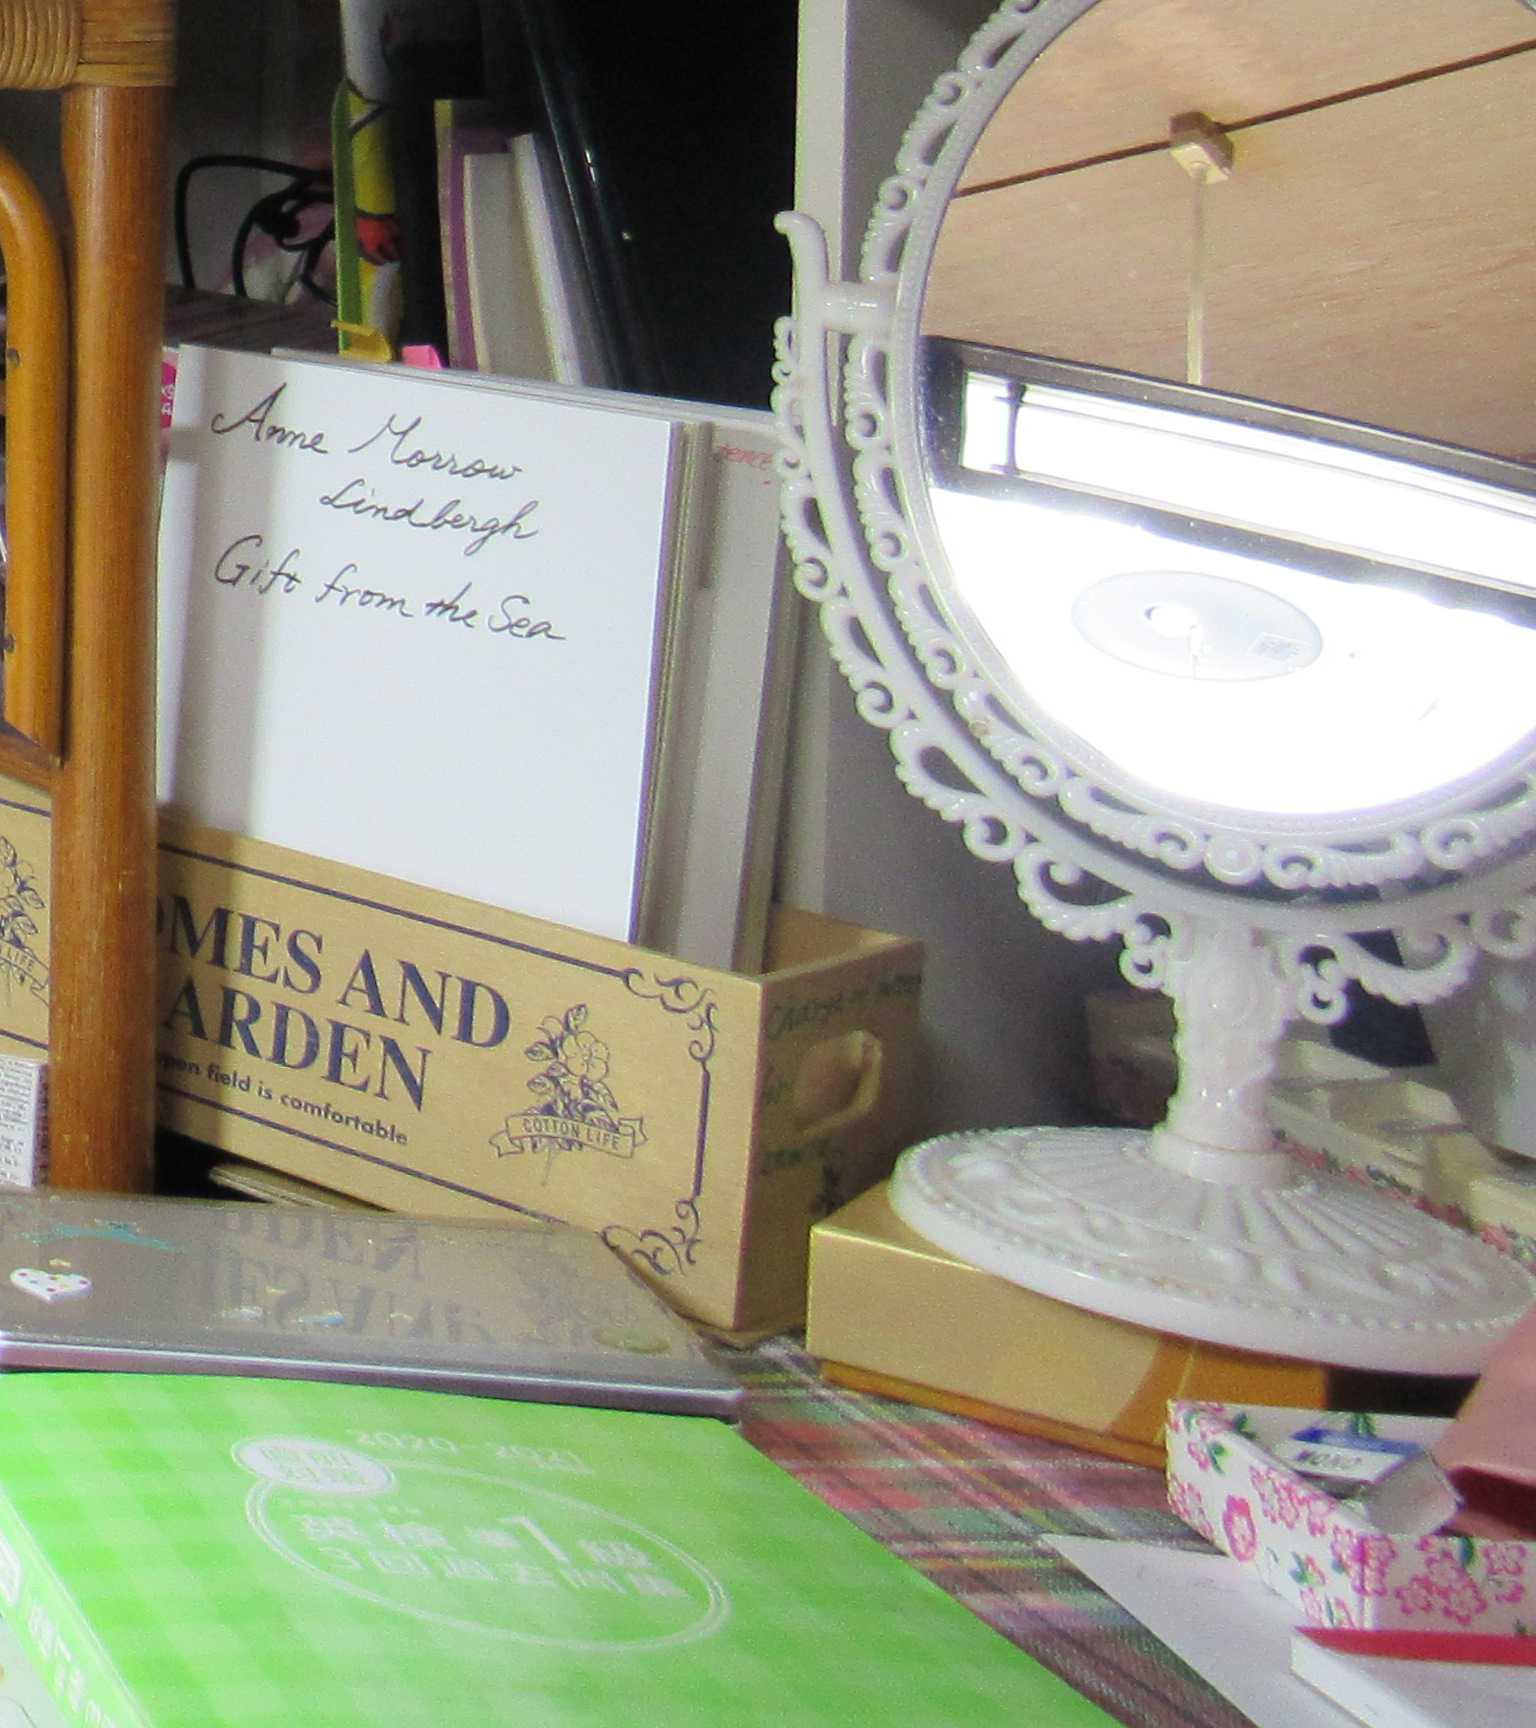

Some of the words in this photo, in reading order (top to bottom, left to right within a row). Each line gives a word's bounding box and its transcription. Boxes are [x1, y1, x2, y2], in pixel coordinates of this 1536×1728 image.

[211, 382, 330, 454] Anne
[347, 413, 524, 481] Morrow
[318, 478, 539, 557] Lindbergh
[213, 534, 304, 596] Gift
[314, 563, 415, 619] from
[423, 582, 480, 630] the
[485, 594, 568, 643] Sea
[157, 893, 324, 995] MES
[337, 948, 512, 1049] AND
[161, 974, 433, 1113] ARDEN
[207, 1062, 250, 1096] field
[256, 1078, 274, 1102] is
[280, 1089, 410, 1148] comfortable
[522, 1117, 580, 1138] COTTON
[585, 1127, 622, 1151] LIFE
